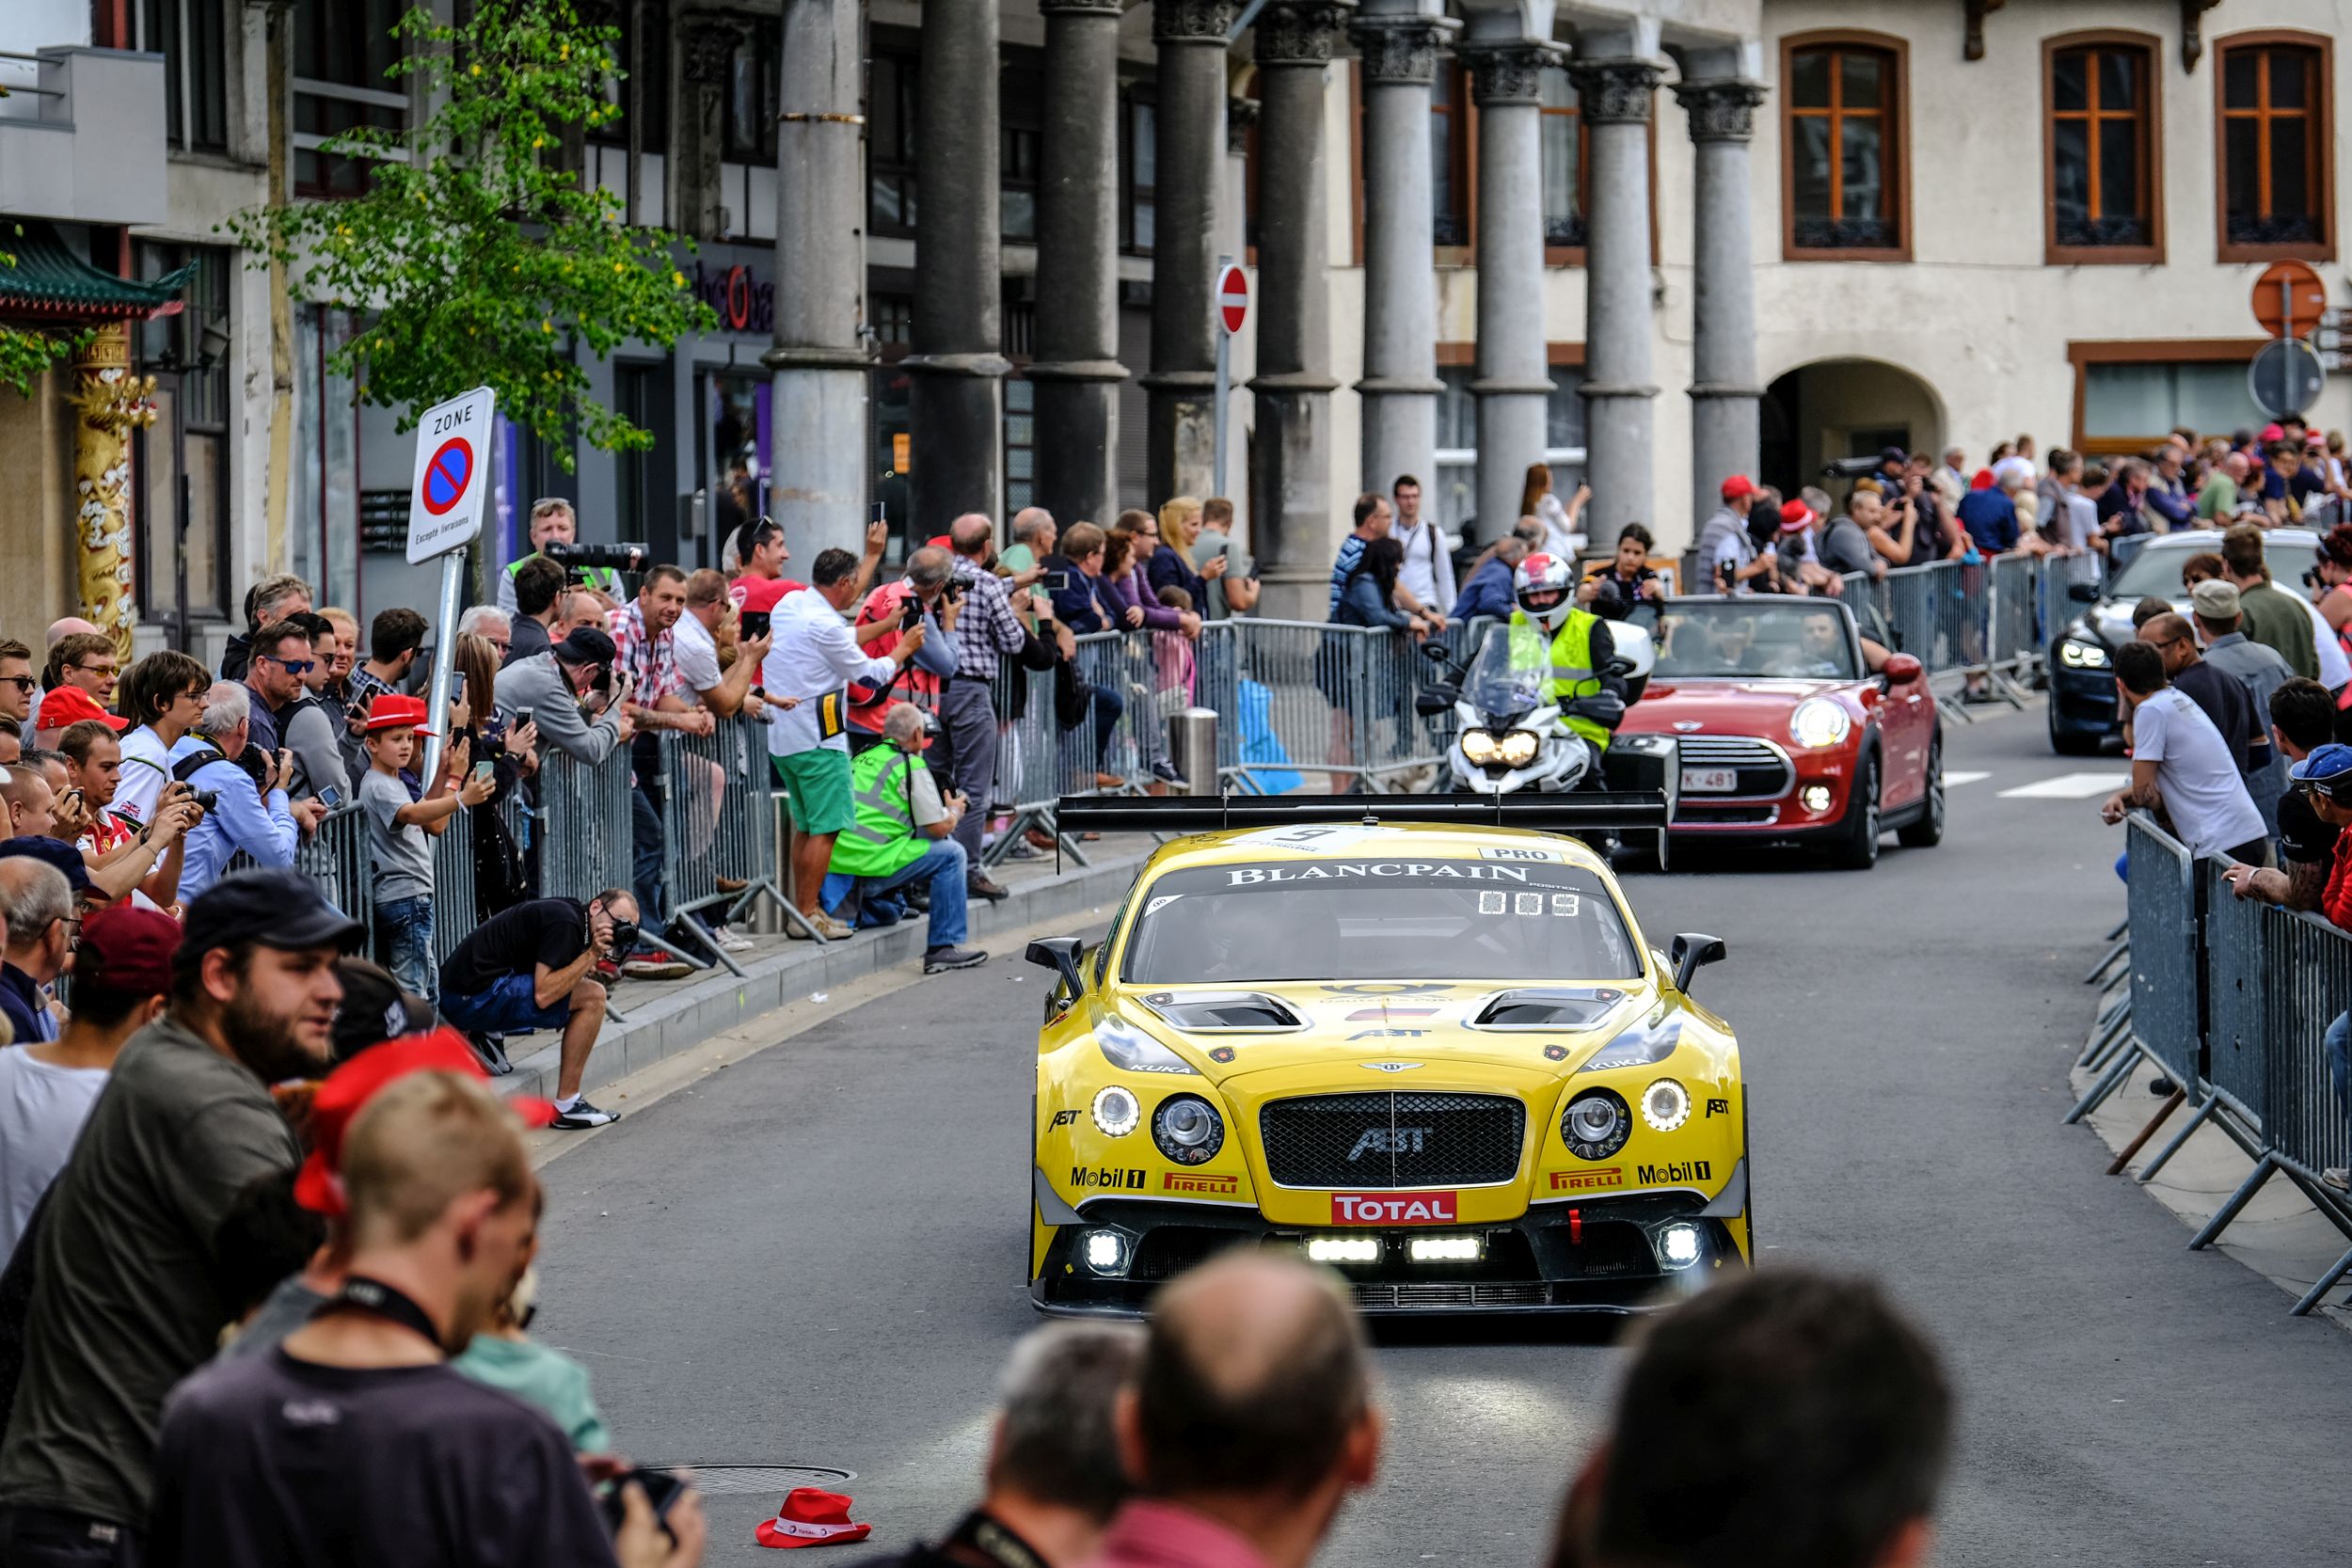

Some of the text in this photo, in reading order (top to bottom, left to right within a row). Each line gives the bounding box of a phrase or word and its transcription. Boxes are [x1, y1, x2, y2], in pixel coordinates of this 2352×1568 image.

[434, 405, 472, 436] ZONE
[415, 516, 469, 545] Excepté livraisons
[1273, 829, 1338, 842] 9
[1494, 848, 1549, 860] PRO
[1227, 863, 1530, 886] BLANCPAIN
[1529, 882, 1581, 892] POSITION
[1344, 1029, 1432, 1041] ABT
[1130, 1064, 1191, 1074] KUKA
[1588, 1057, 1651, 1070] KUKA
[1706, 1099, 1729, 1118] ABT
[1048, 1110, 1082, 1132] ABT
[1346, 1128, 1434, 1162] ABT
[1071, 1167, 1143, 1188] Mobil 1
[1163, 1172, 1238, 1194] PIRELLI
[1549, 1167, 1622, 1190] PIRELLI
[1637, 1162, 1709, 1185] Mobil 1
[1335, 1196, 1454, 1221] TOTAL
